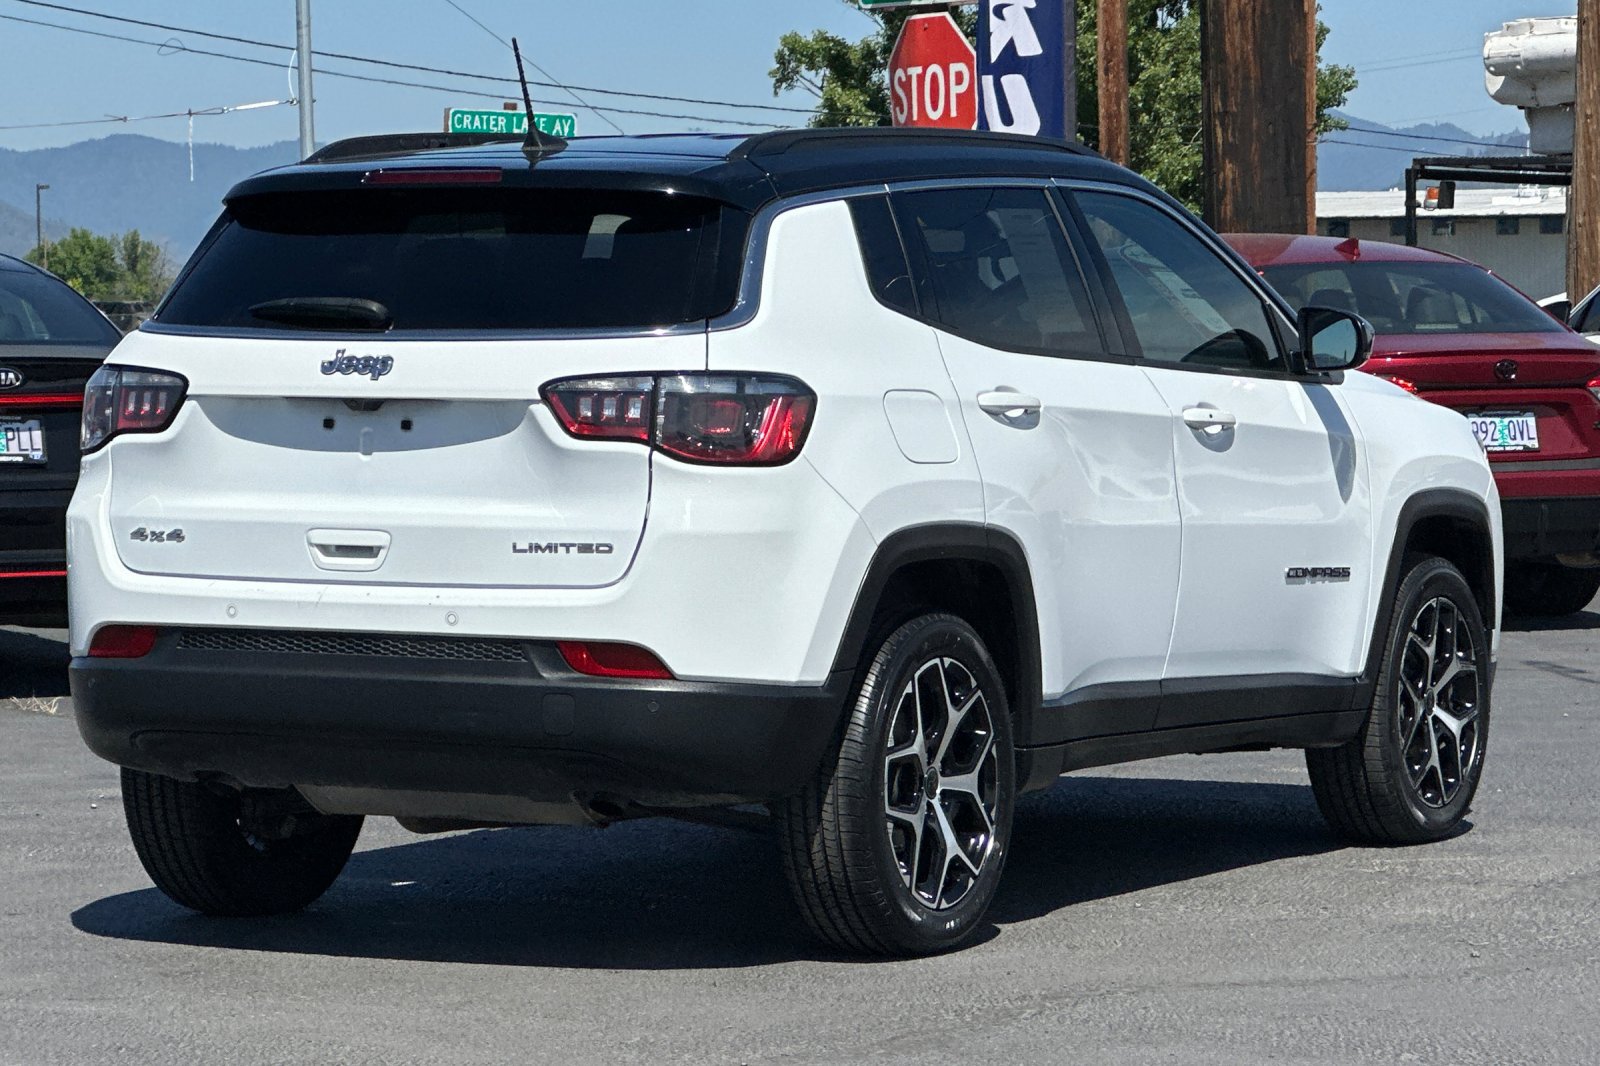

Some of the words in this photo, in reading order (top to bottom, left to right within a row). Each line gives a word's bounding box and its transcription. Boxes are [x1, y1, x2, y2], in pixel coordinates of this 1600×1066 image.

[893, 62, 970, 124] STOP
[454, 114, 507, 133] CRATER
[513, 116, 548, 134] LAE
[552, 118, 572, 137] AV
[320, 348, 394, 381] Jeep
[4, 426, 42, 452] PLL
[1507, 419, 1536, 442] QVL
[129, 527, 186, 543] 4x4
[512, 542, 614, 554] LIMITED
[1286, 566, 1351, 579] COMPASS
